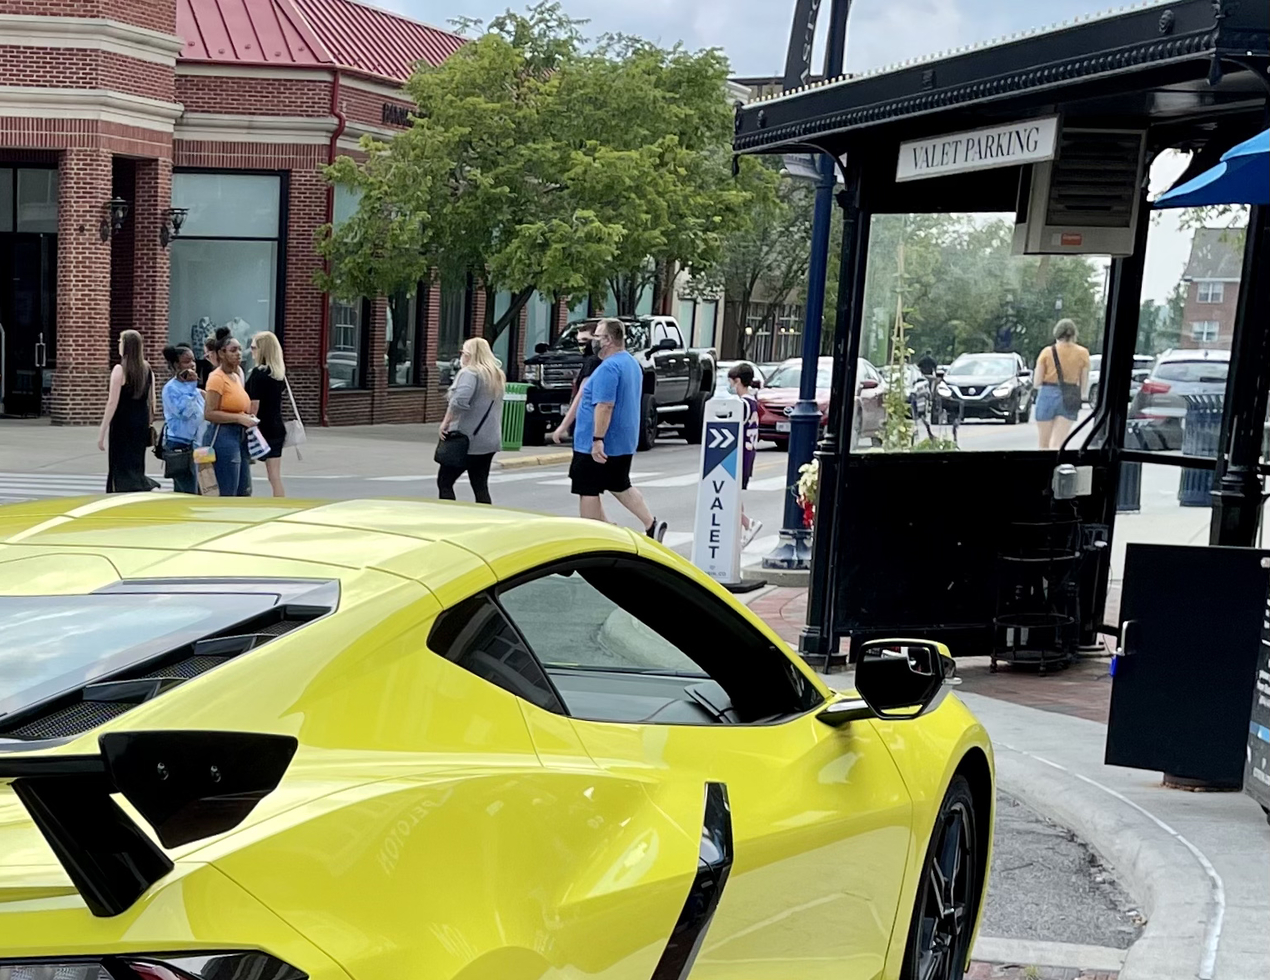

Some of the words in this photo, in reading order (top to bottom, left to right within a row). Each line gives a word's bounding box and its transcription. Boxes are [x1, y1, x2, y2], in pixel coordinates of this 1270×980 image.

[912, 140, 963, 171] VALET
[964, 126, 1040, 163] PARKING
[709, 480, 725, 559] VALET
